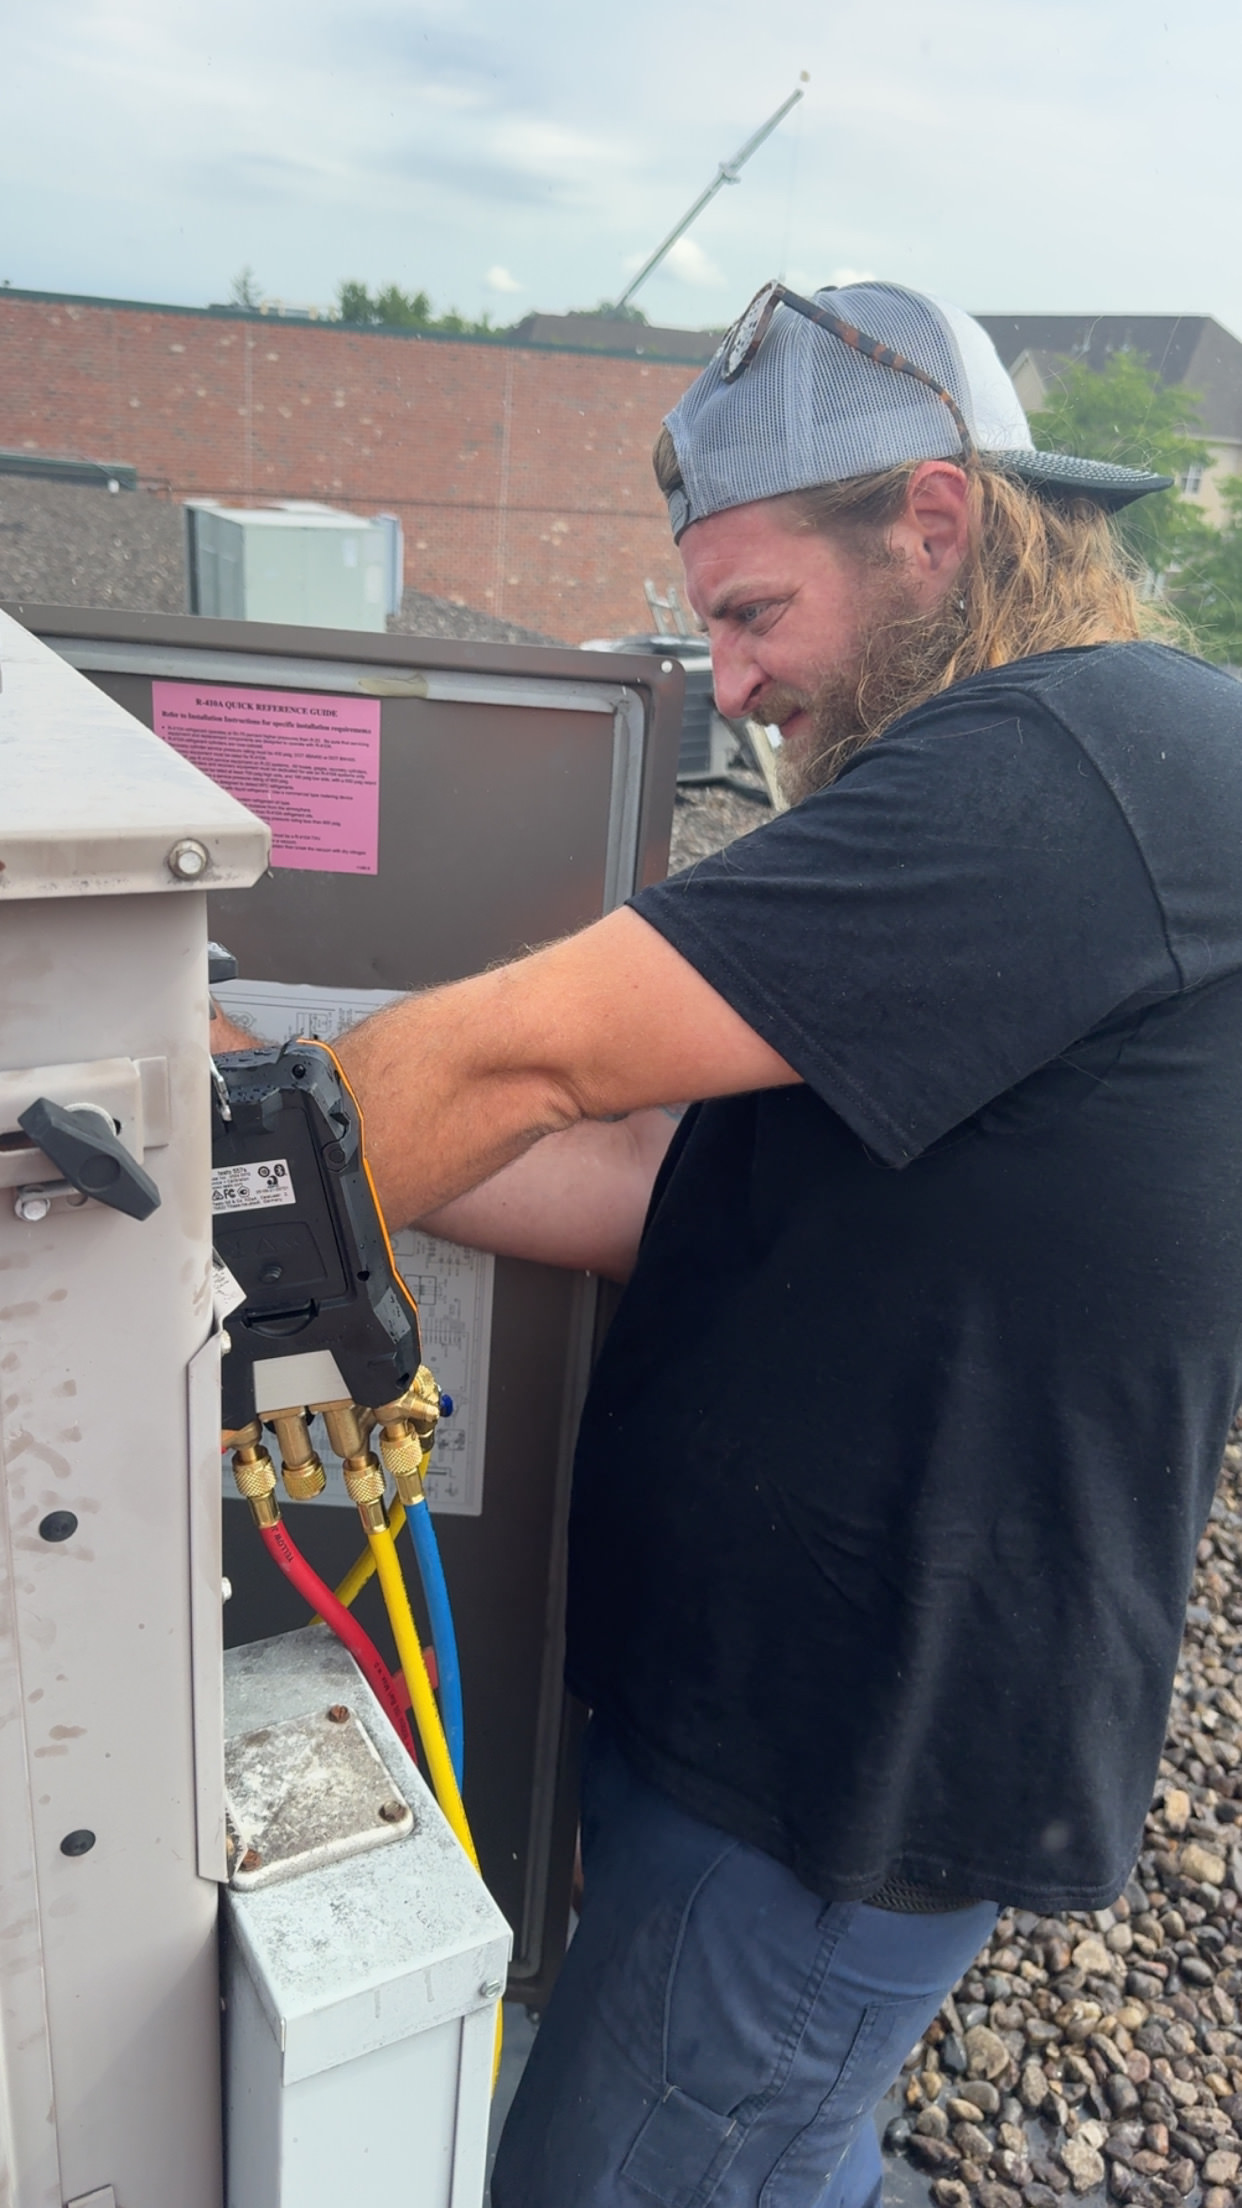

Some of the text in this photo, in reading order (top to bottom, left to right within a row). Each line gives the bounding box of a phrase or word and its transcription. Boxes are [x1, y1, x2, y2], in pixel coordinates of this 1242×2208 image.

[196, 698, 337, 717] R-410A QUICK REFERENCE GUIDE
[188, 713, 223, 722] Installation
[224, 716, 260, 725] Instructions
[296, 723, 330, 731] installation
